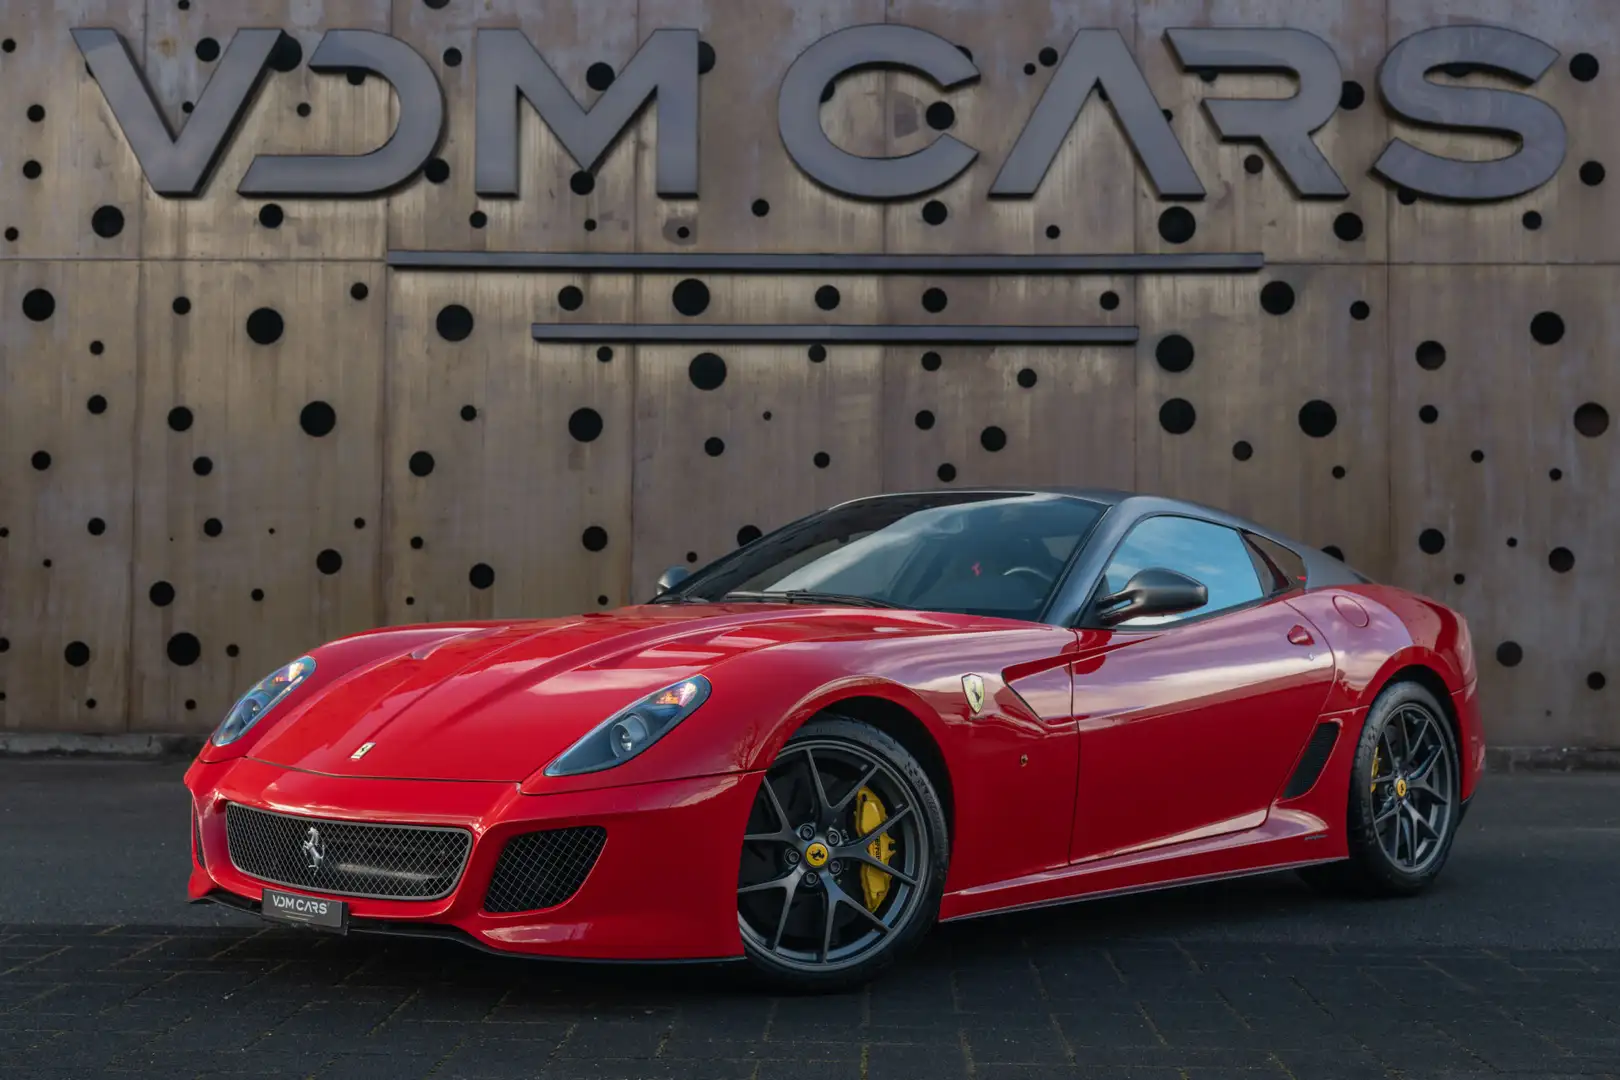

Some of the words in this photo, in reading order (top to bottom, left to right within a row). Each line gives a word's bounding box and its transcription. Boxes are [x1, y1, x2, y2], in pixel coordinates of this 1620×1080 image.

[69, 27, 700, 197] VDM
[777, 23, 1568, 200] CARS
[272, 895, 295, 909] VDM
[296, 899, 327, 914] CARS
